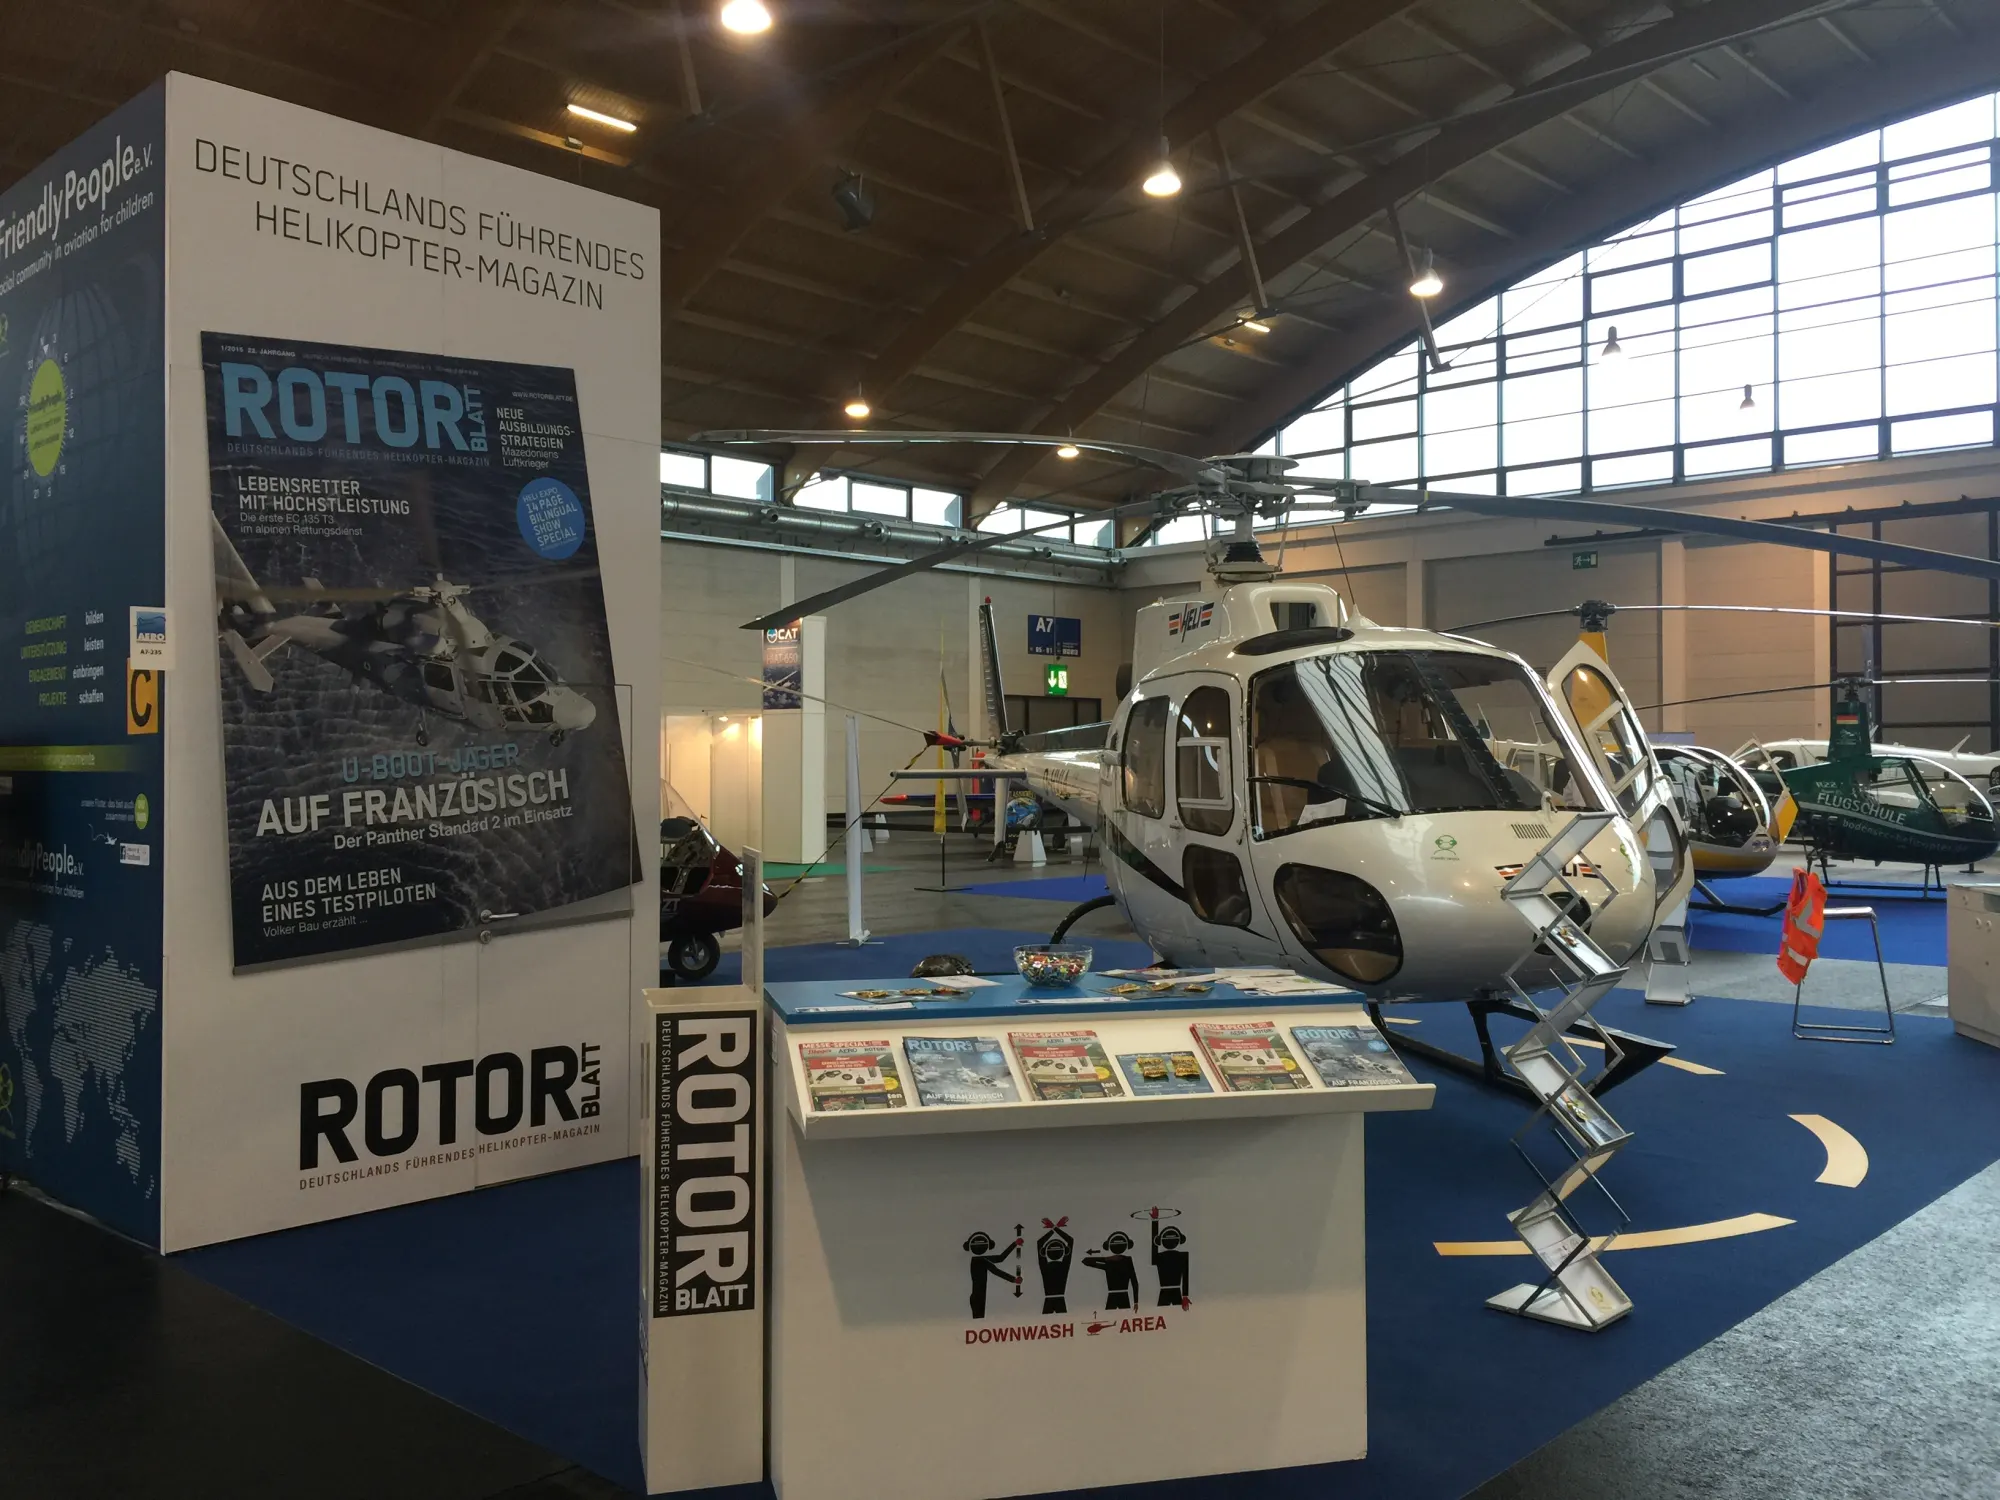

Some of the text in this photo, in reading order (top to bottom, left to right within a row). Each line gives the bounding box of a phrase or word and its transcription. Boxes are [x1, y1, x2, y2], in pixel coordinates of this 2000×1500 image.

[195, 138, 645, 280] DEUTSCHLANDS FÜHRENDES
[16, 249, 52, 285] community
[55, 242, 62, 260] in
[64, 224, 98, 257] aviation
[100, 213, 113, 236] for
[115, 190, 154, 225] children
[256, 201, 602, 310] HELIKOPTER-MAGAZIN
[221, 345, 244, 354] 1/2015
[259, 348, 296, 358] JAHRGANG
[221, 361, 471, 451] ROTOR
[512, 391, 574, 402] WWW.ROTORBLATT.DE
[464, 384, 488, 452] BLATT
[496, 407, 524, 420] NEUE
[499, 420, 575, 436] AUSBILDUNGS-
[500, 434, 564, 449] STRATEGIEN
[227, 442, 490, 467] DEUTSCHLANDS FÜHRENDES HELIKOPTER-MAGAZIN
[501, 446, 559, 459] Mazedoniens
[503, 457, 549, 470] Luftkrieger
[238, 475, 360, 495] LEBENSRETTER
[522, 487, 558, 503] HELI EXPO
[239, 493, 410, 515] MIT HÖCHSTLEISTUNG
[526, 494, 564, 514] 14 PAGE
[529, 502, 578, 525] BILINGUAL
[240, 513, 334, 525] Die erste EC 135 T3
[533, 519, 561, 536] SHOW
[240, 524, 363, 538] im alpinen Rettungsdienst
[537, 526, 576, 547] SPECIAL
[85, 610, 104, 625] bilden
[1036, 617, 1053, 633] A7
[84, 637, 104, 651] leisten
[138, 632, 166, 641] AERO
[73, 664, 104, 680] einbringen
[79, 688, 104, 703] schaffen
[131, 669, 152, 727] C
[342, 742, 519, 783] U-BOOT-JÄGER
[256, 768, 569, 837] AUF FRANZÖSISCH
[1817, 792, 1907, 826] FLUGSCHULE
[334, 833, 362, 850] Der
[366, 826, 425, 847] Panther
[492, 815, 501, 830] 2
[504, 813, 521, 828] im
[524, 804, 573, 824] Einsatz
[262, 868, 401, 901] AUS DEM LEBEN
[263, 883, 436, 923] EINES TESTPILOTEN
[263, 924, 296, 938] Volker
[299, 919, 320, 933] Bau
[322, 915, 356, 931] erzählt
[802, 1041, 869, 1049] MESSE-SPECIAL
[907, 1039, 966, 1051] ROTOR
[1295, 1029, 1350, 1040] ROTOR
[580, 1042, 600, 1119] BLATT
[300, 1045, 579, 1170] ROTOR
[300, 1123, 600, 1190] DEUTSCHLANDS FÜHRENDES HELIKOPTER-MAGAZIN
[675, 1017, 751, 1288] ROTOR
[658, 1020, 671, 1312] DEUTSCHLANDS FÜHRENDES HELIKOPTER-MAGAZIN
[675, 1284, 748, 1311] BLATT
[965, 1316, 1167, 1345] DOWNWASH AREA
